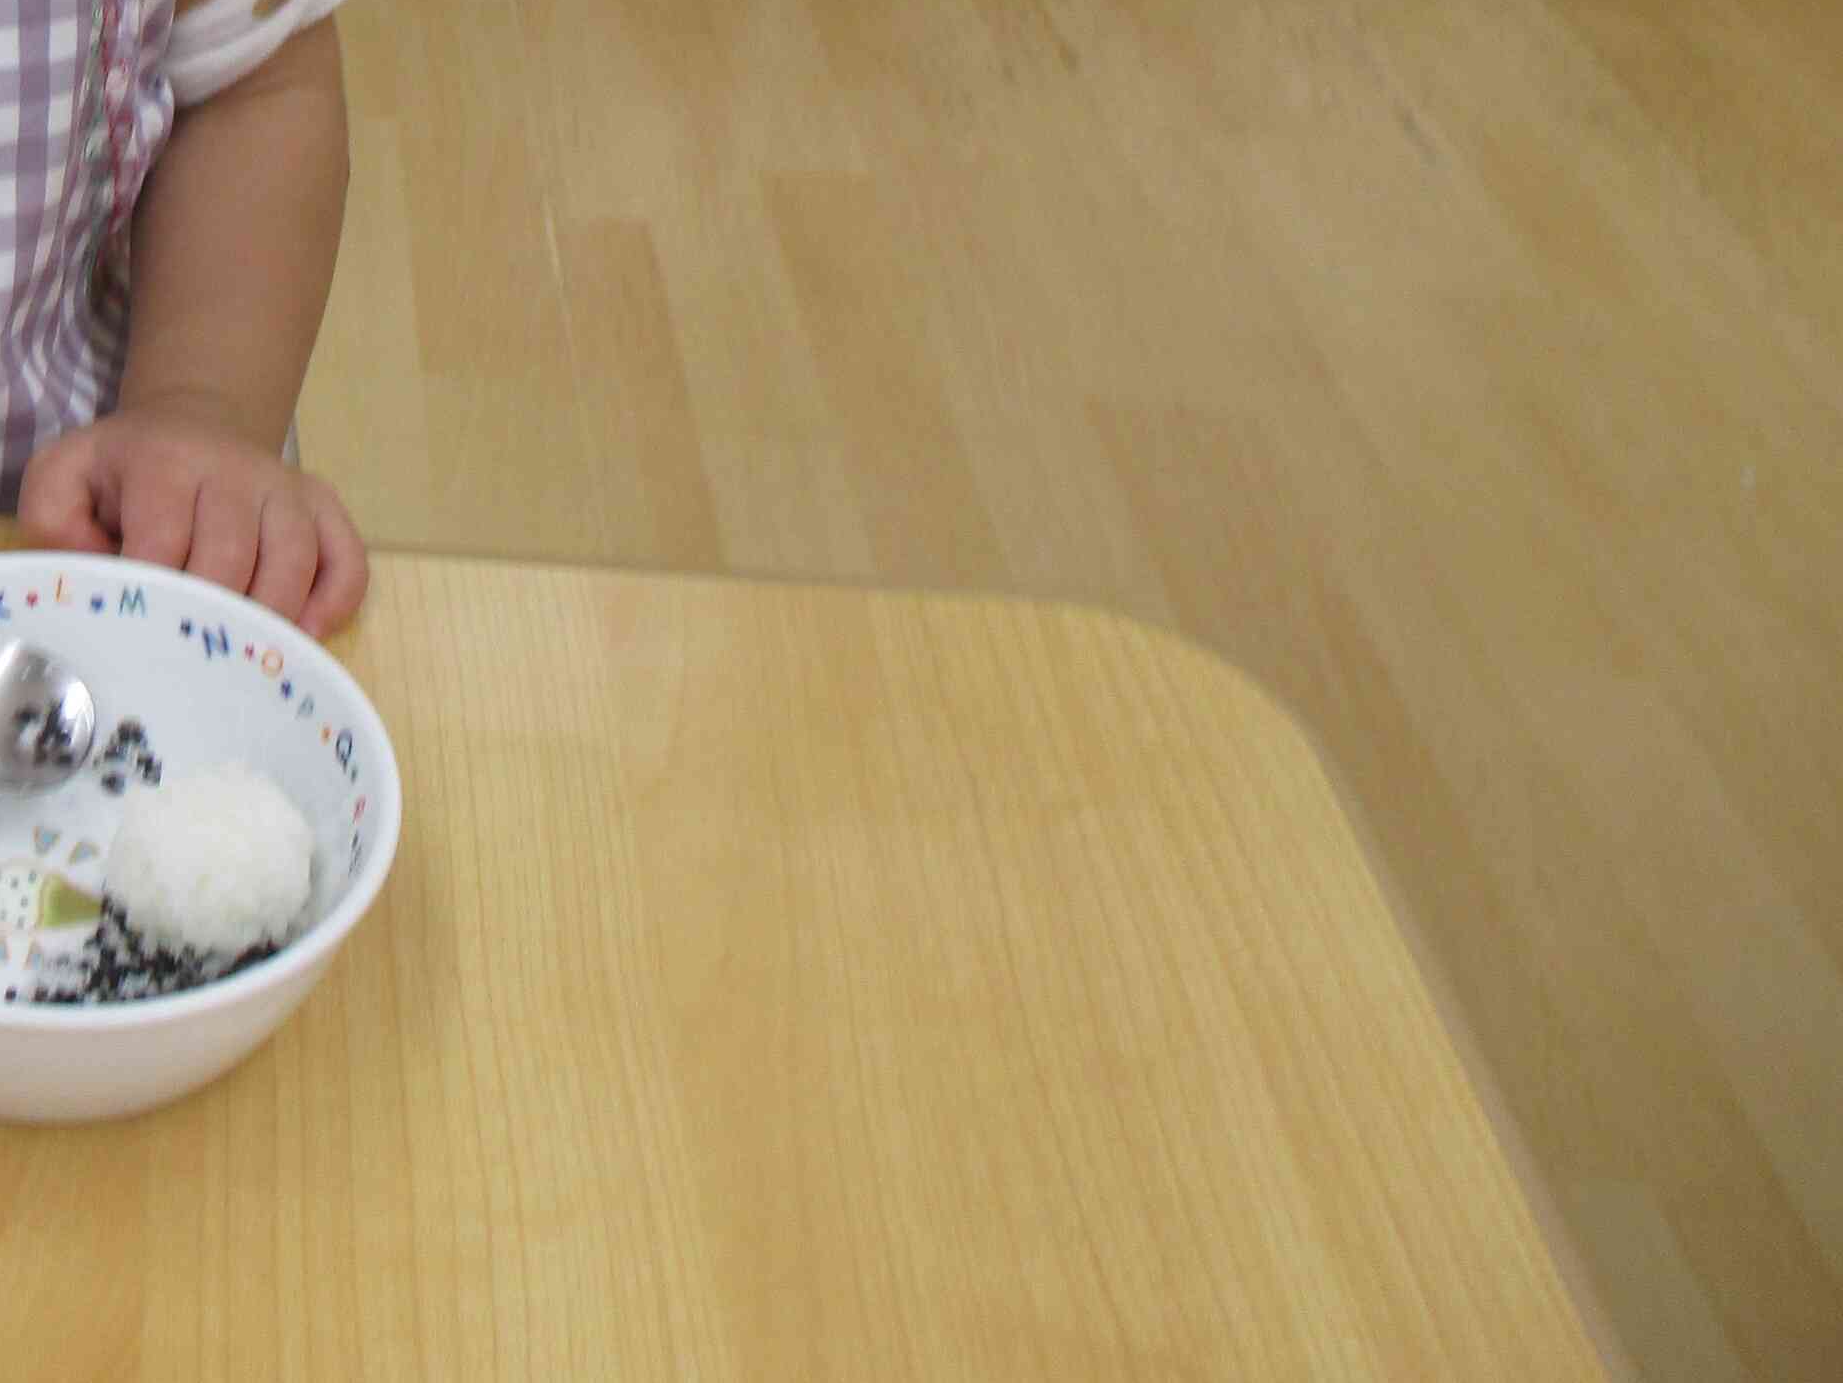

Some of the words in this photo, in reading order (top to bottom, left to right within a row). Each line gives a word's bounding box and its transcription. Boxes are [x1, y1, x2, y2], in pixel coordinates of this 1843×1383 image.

[119, 583, 146, 617] M
[202, 623, 230, 660] N
[260, 648, 284, 679] O
[335, 728, 353, 774] Q
